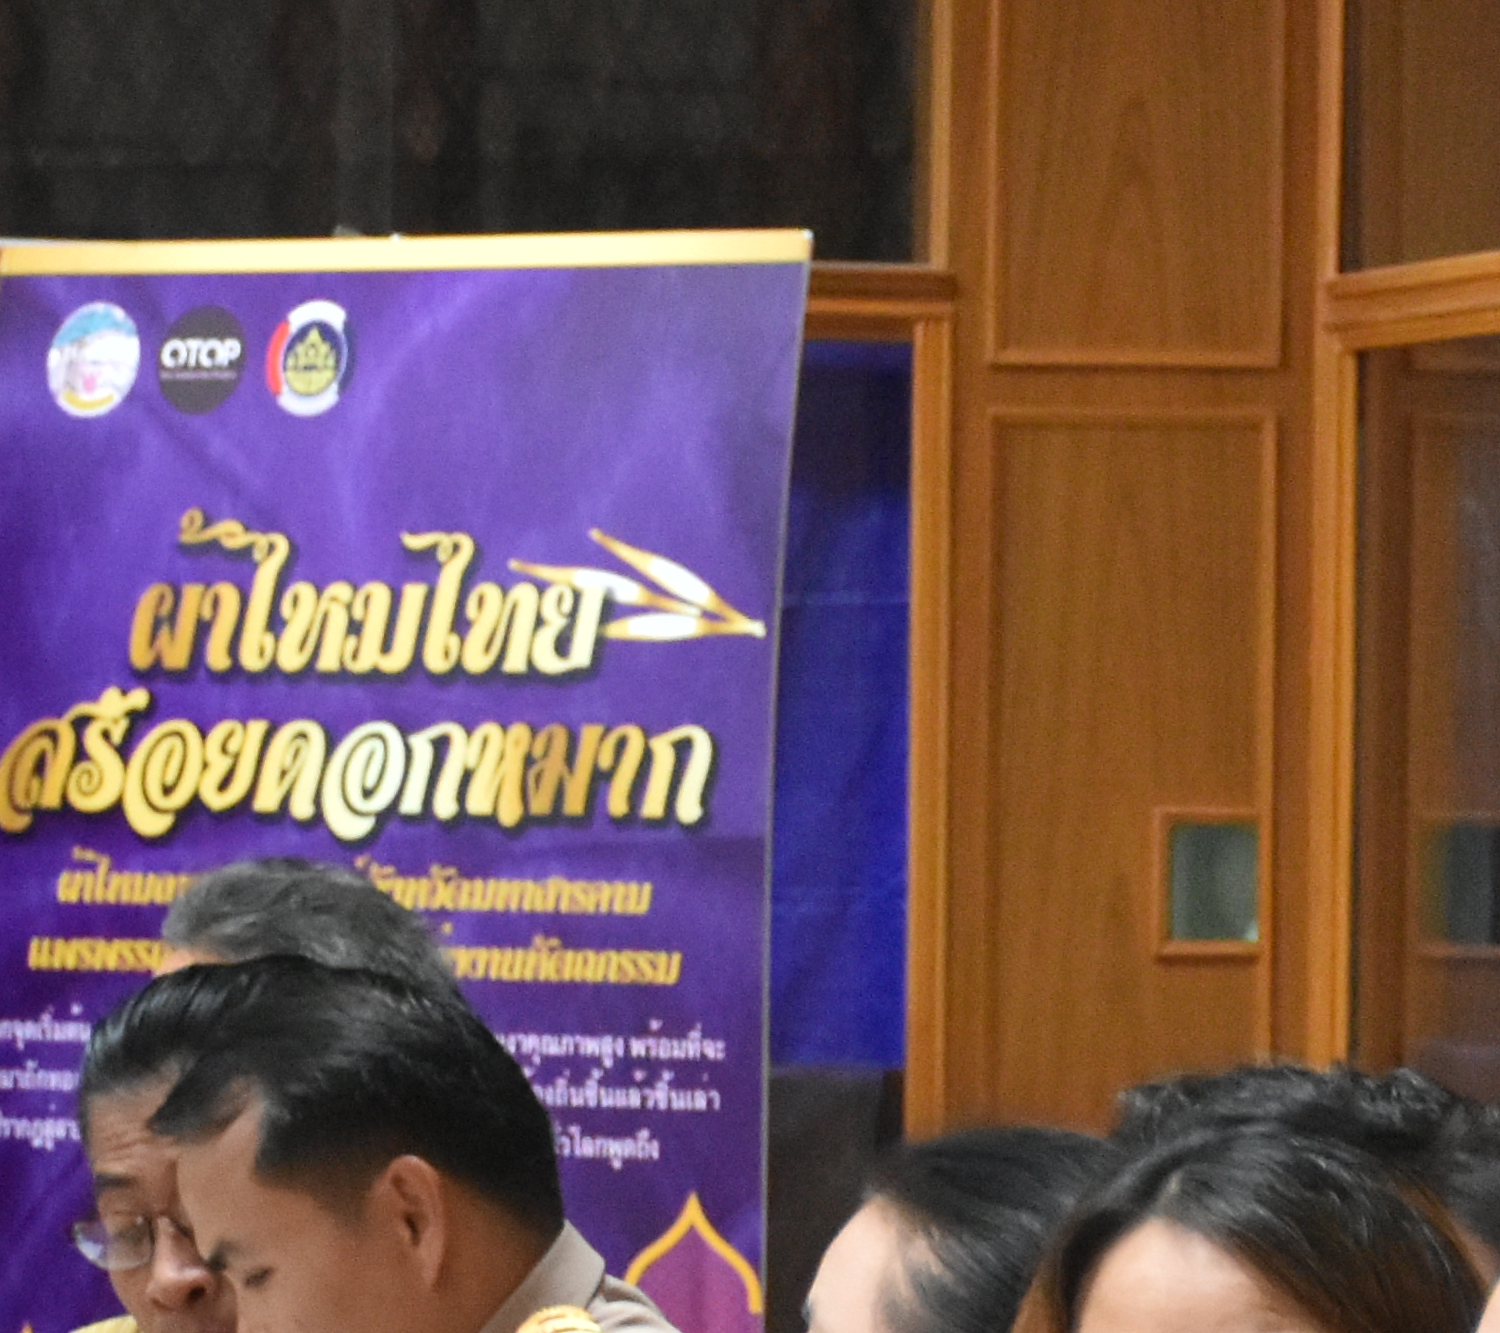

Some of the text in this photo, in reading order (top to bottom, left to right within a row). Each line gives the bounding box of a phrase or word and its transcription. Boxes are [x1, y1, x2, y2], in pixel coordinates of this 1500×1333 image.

[160, 337, 242, 368] OTOP
[129, 506, 614, 676] ผ้าไหมไทย
